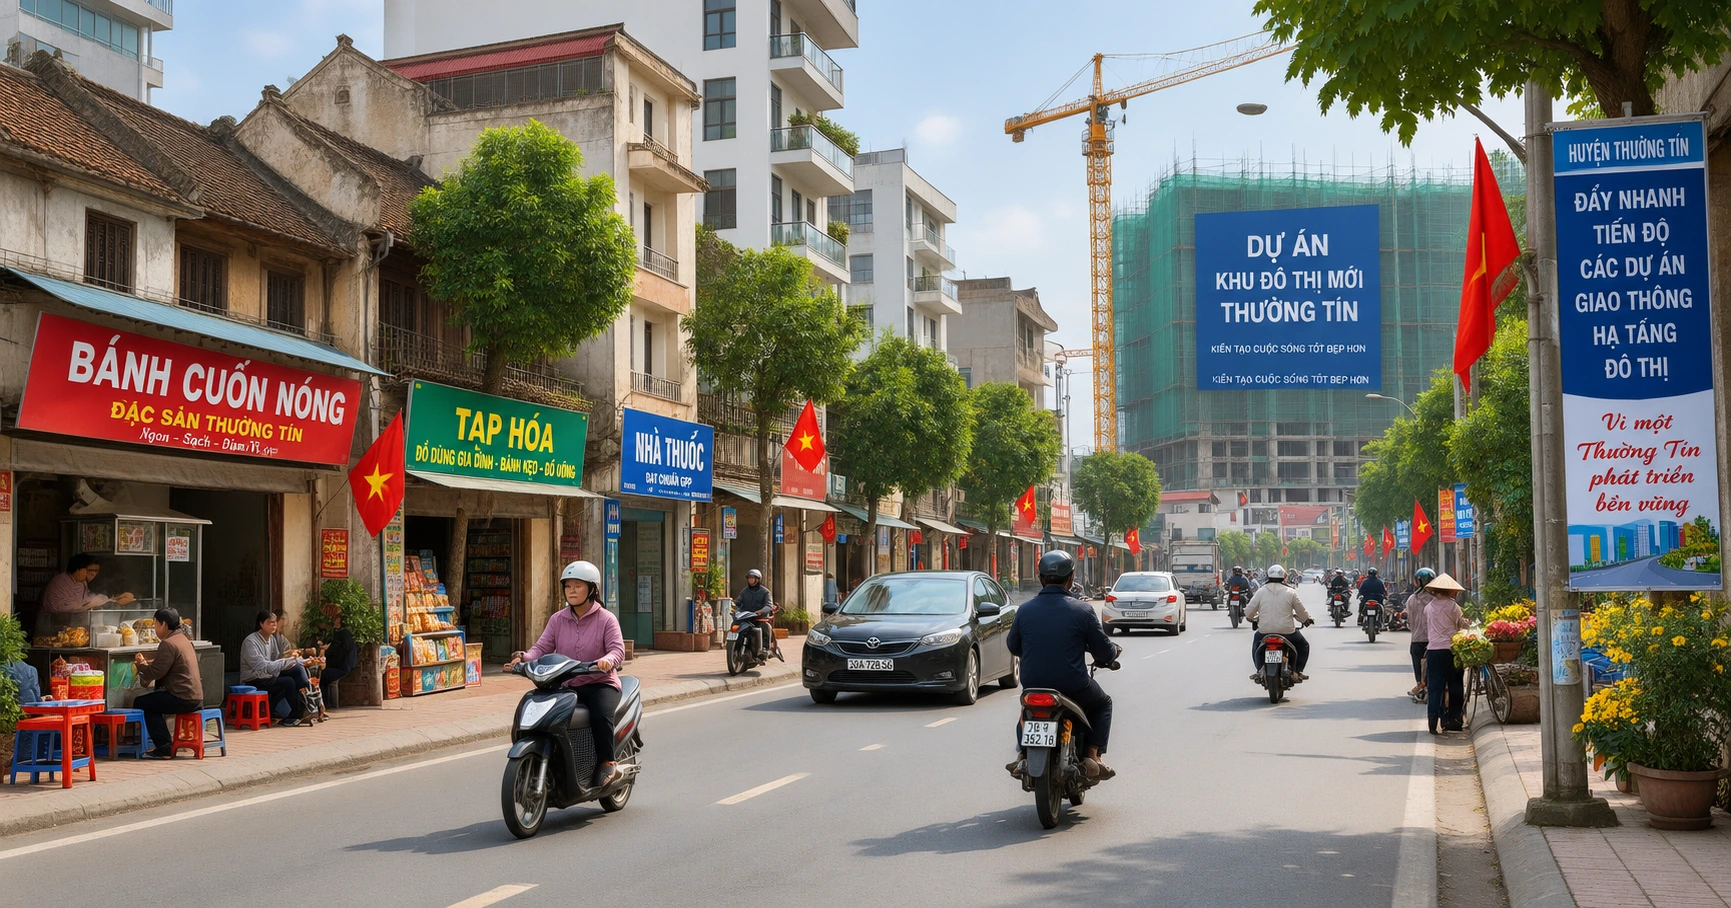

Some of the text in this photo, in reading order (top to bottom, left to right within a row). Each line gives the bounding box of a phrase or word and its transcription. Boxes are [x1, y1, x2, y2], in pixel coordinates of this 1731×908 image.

[1668, 133, 1689, 157] TÍN
[1619, 187, 1685, 210] NHANH
[1593, 217, 1670, 246] TIẾN ĐỘ
[1247, 229, 1329, 263] DỰ ÁN
[1580, 250, 1685, 281] CÁC DỰ ÁN
[1216, 266, 1364, 294] KHU ĐÔ THỊ MỚI
[1322, 297, 1358, 322] TÍN
[1575, 284, 1692, 312] GIAO THÔNG
[1593, 325, 1620, 349] HẠ
[68, 334, 172, 397] BÁNH
[275, 376, 346, 425] NÓNG
[1604, 353, 1668, 382] ĐÔ THỊ
[278, 424, 304, 442] TÍN
[508, 412, 554, 453] HÓA
[1634, 414, 1674, 434] một
[635, 426, 662, 466] NHÀ
[1664, 439, 1701, 459] Tín
[1588, 467, 1640, 492] phát
